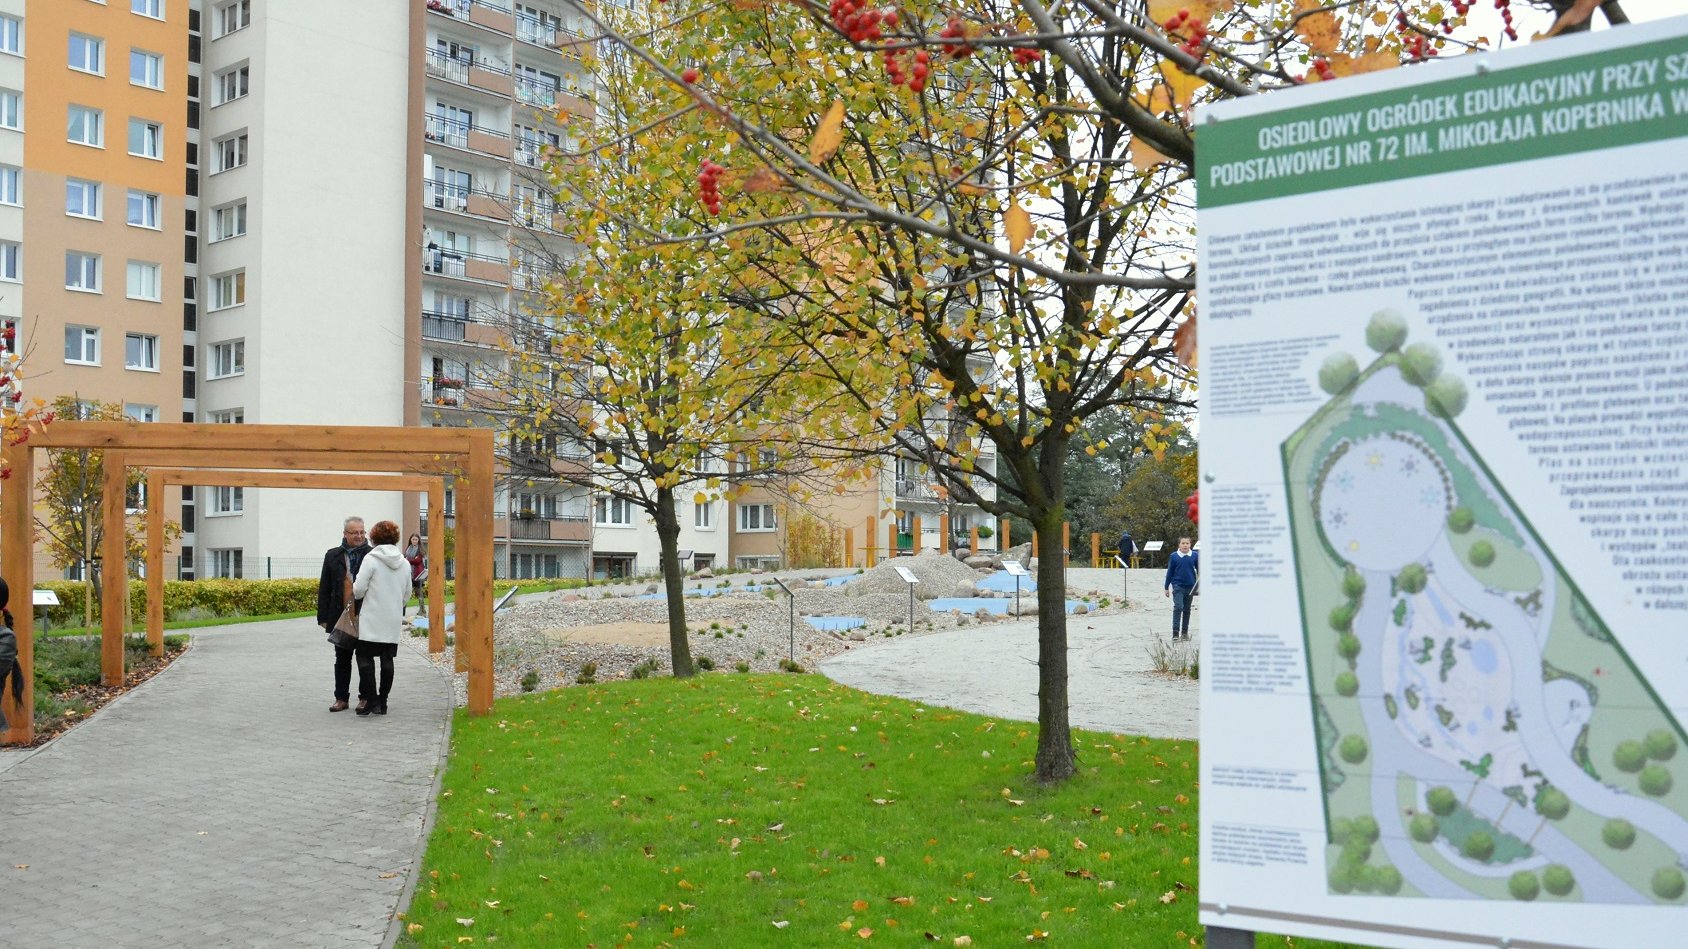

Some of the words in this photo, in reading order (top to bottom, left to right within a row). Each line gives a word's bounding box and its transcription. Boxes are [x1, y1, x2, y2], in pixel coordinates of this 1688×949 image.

[1210, 147, 1341, 189] PODSTAWOWEJ
[1345, 139, 1372, 167] NR
[1377, 136, 1400, 162] 72
[1404, 130, 1434, 158] IM.
[1438, 112, 1536, 154] MIKOŁAJA
[1542, 91, 1665, 136] KOPERNIKA
[1258, 112, 1373, 151] OSIEDLOWY
[1367, 93, 1458, 134] OGRÓDEK
[1463, 71, 1596, 115] EDUKACYJNY
[1602, 57, 1660, 94] PRZY
